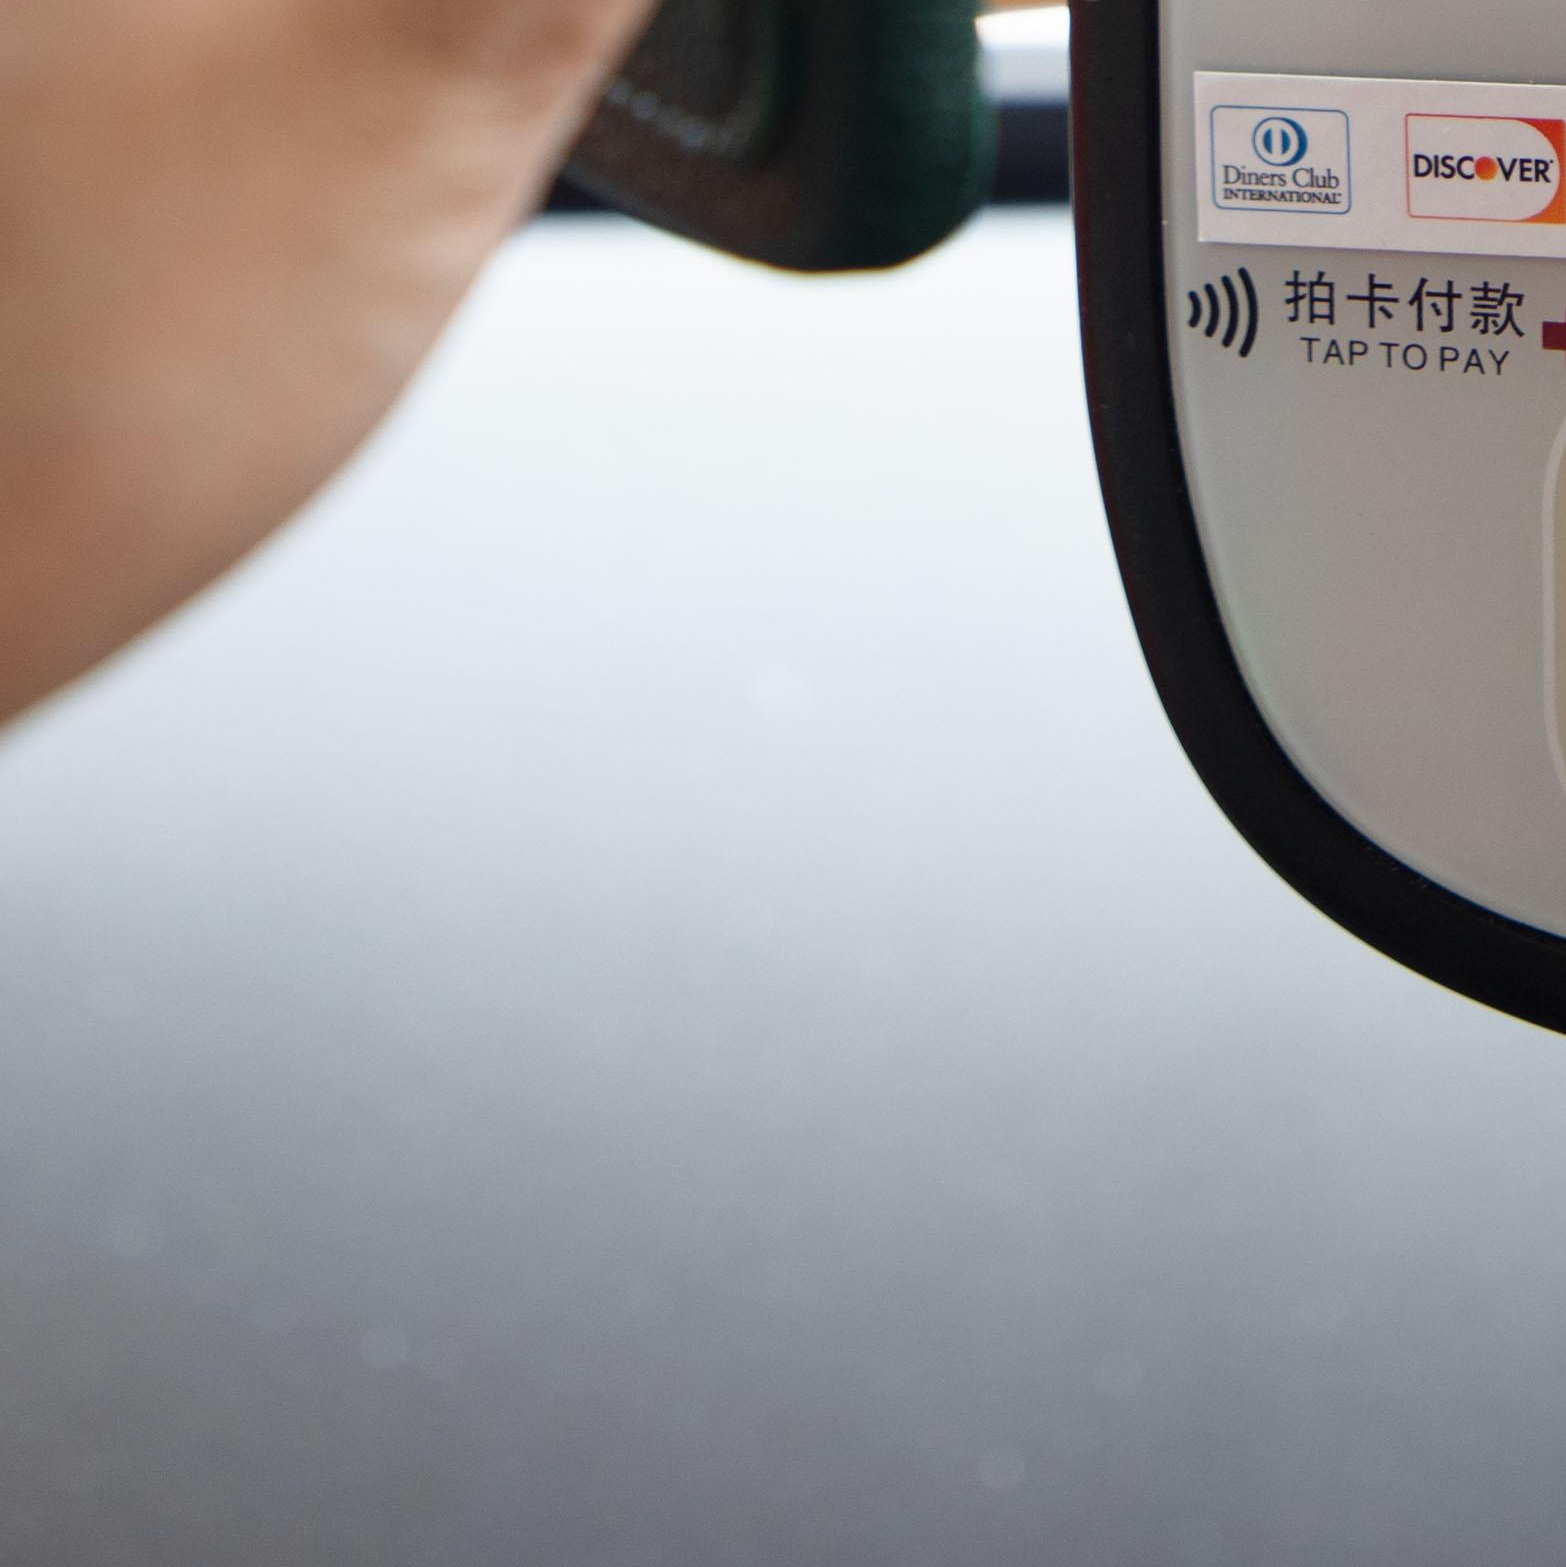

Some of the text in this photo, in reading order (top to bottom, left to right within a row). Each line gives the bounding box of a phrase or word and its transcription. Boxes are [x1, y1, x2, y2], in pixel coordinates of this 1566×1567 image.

[1223, 164, 1341, 190] Diners Club
[1412, 153, 1554, 184] DISCOVER
[1222, 188, 1342, 205] INTERNATIONAL
[1285, 269, 1525, 338] 拍卡付款
[1299, 336, 1510, 376] TAP TO PAY
